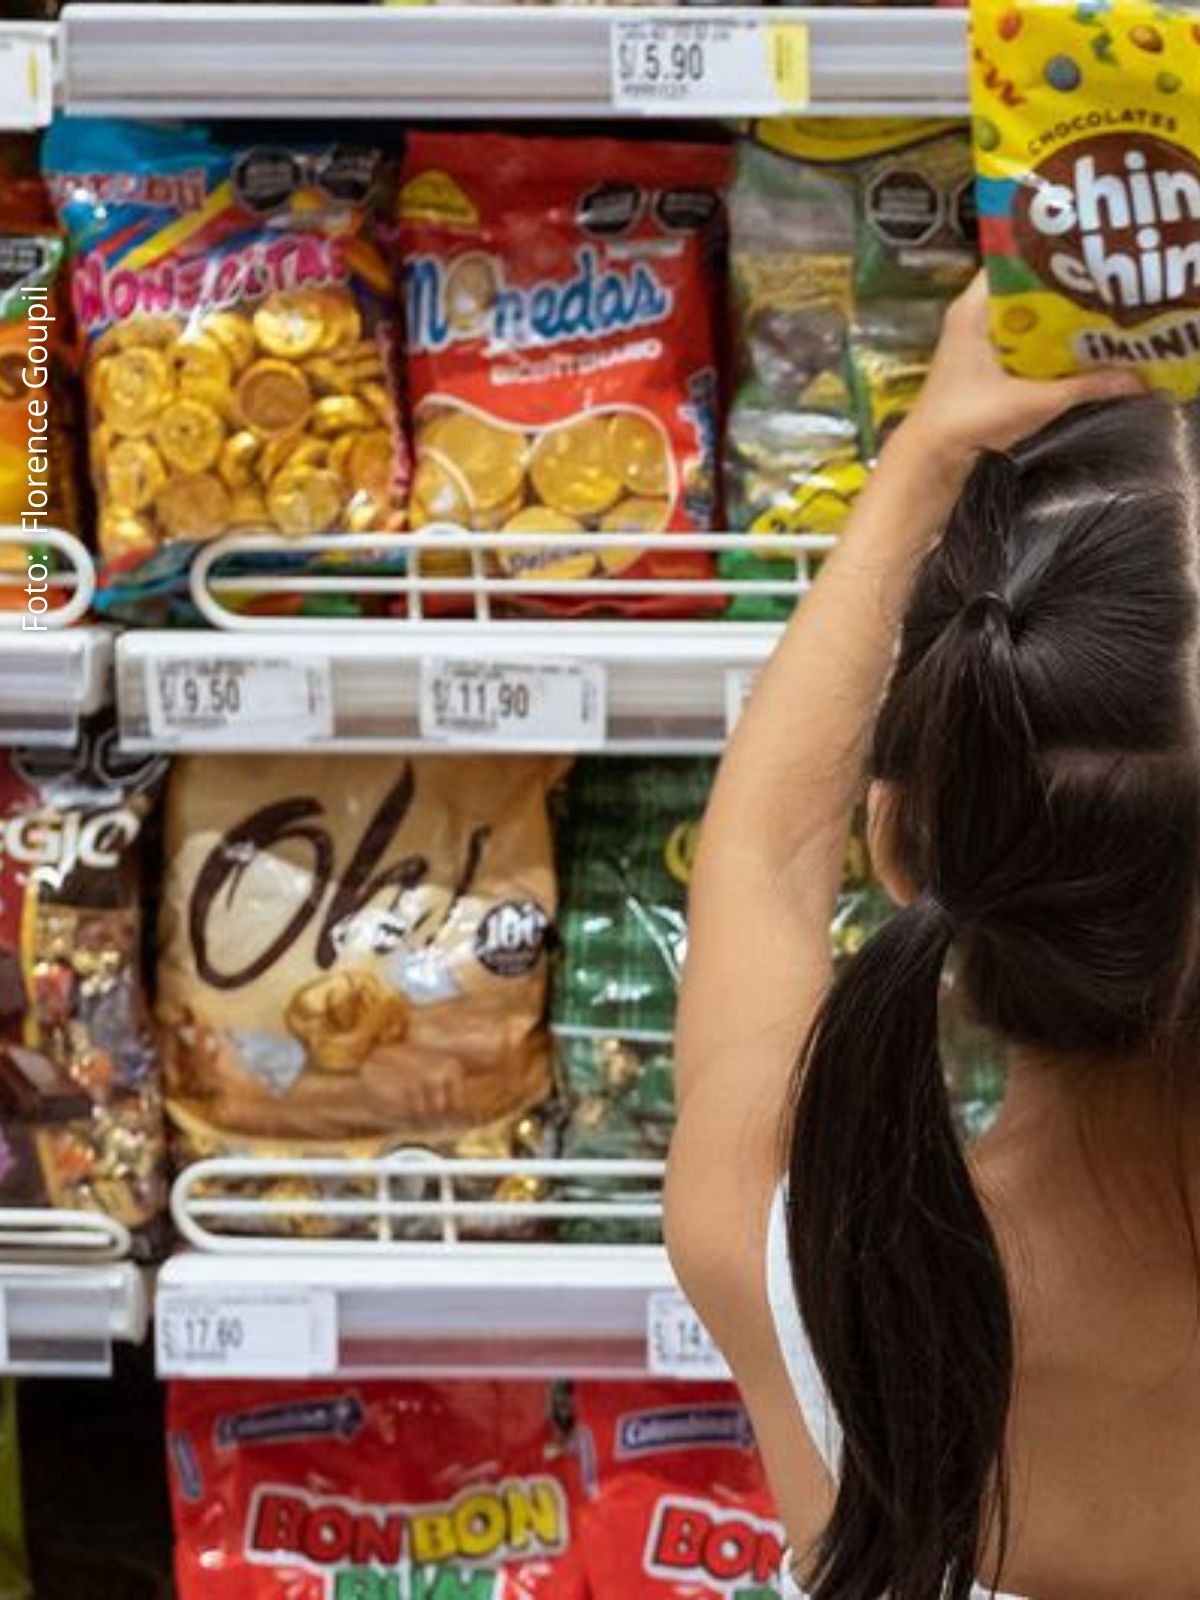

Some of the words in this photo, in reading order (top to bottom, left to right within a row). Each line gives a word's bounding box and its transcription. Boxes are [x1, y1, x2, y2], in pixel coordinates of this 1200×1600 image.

[645, 42, 704, 80] 5.90
[1027, 108, 1178, 157] CHOCOLATES
[184, 678, 241, 713] 9.50
[458, 681, 532, 718] 11.90
[185, 1317, 244, 1349] 17.60
